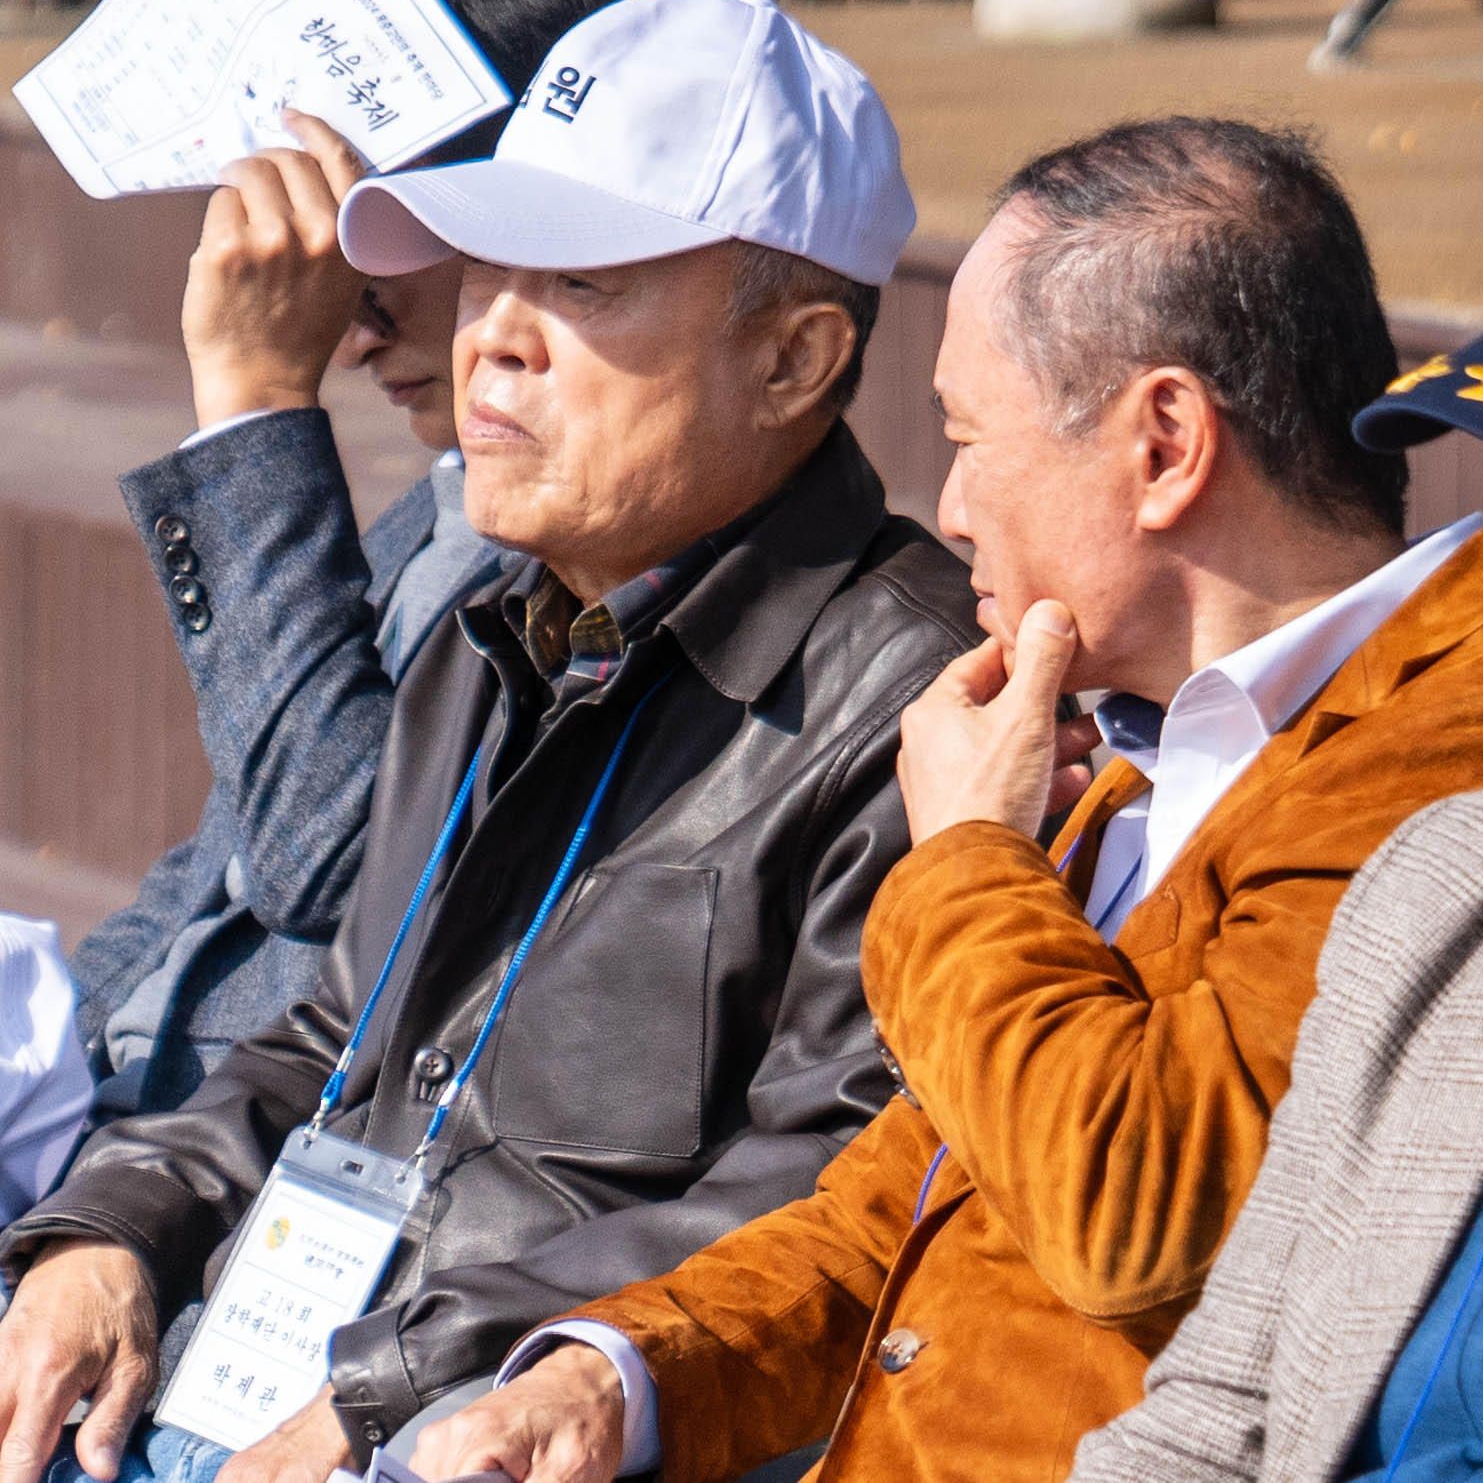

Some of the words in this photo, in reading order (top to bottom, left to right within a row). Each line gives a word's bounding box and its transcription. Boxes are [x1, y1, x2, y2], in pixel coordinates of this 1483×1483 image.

[300, 17, 362, 78] 한마음
[347, 76, 400, 132] 축제
[518, 60, 597, 124] 원
